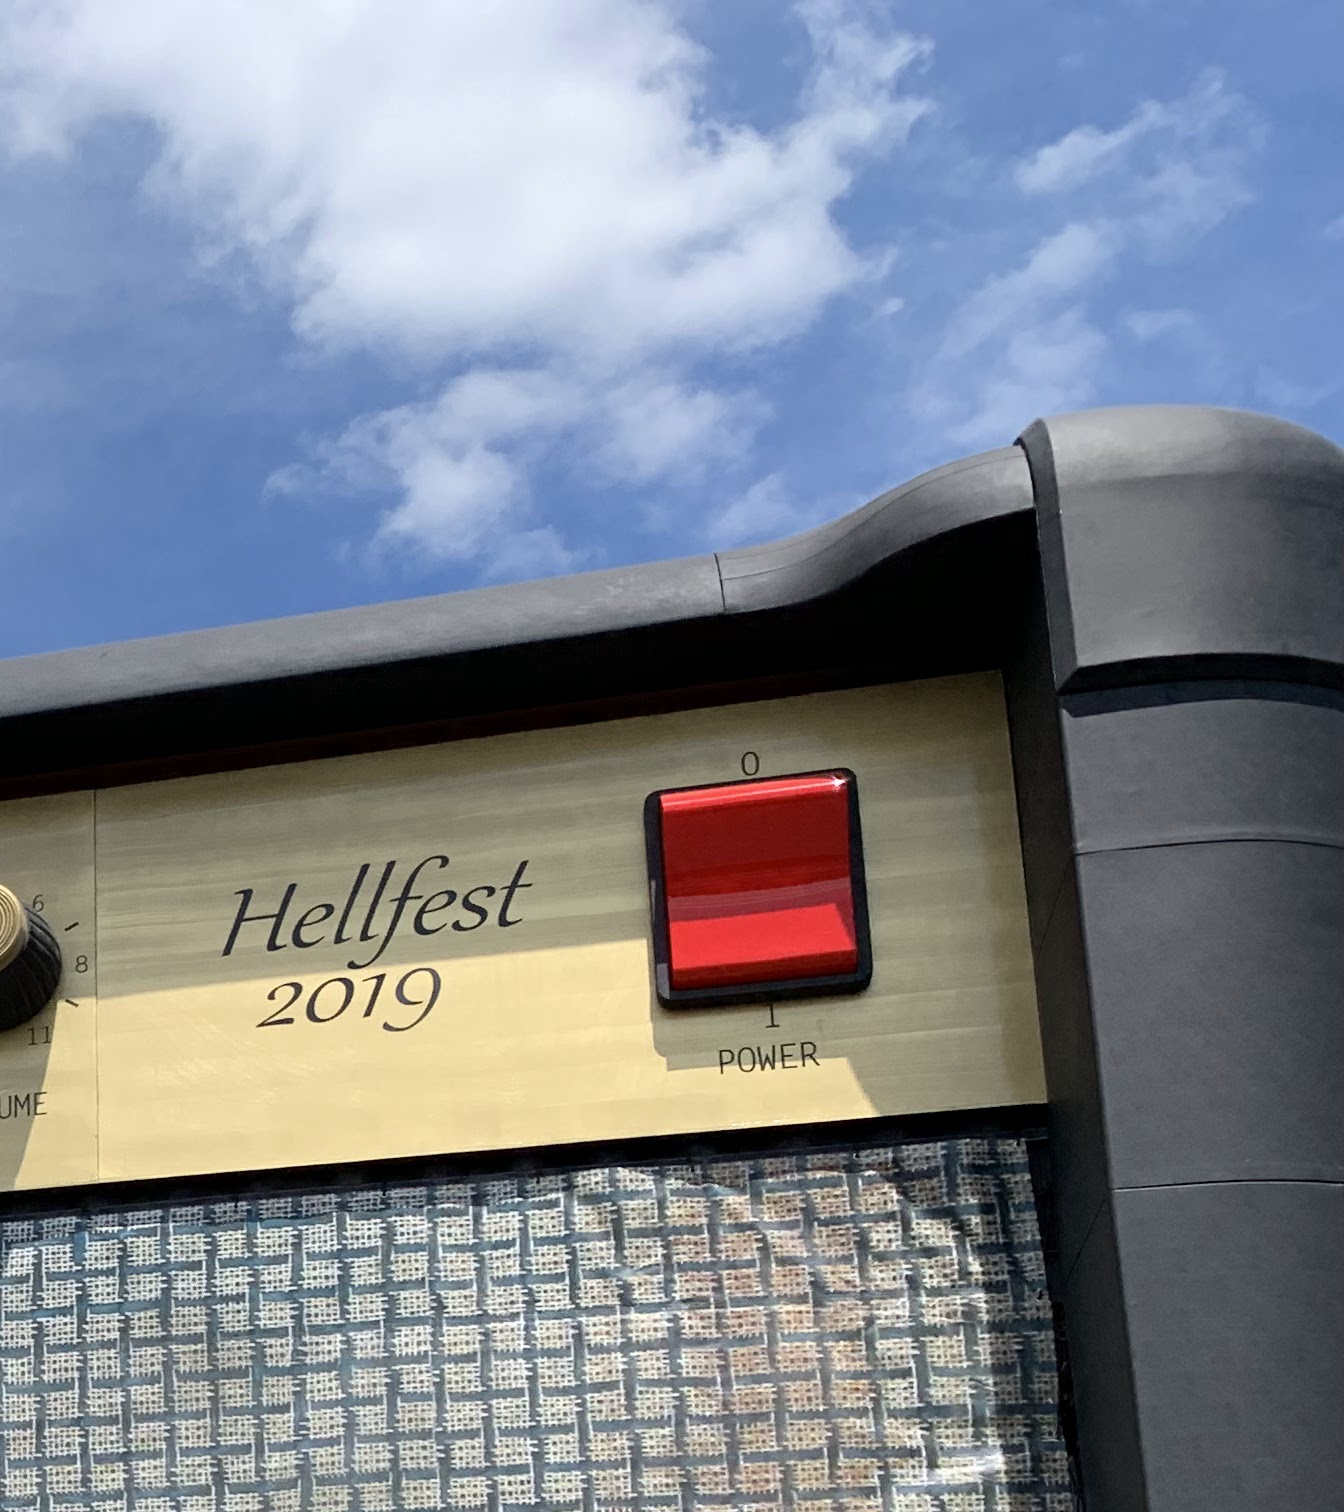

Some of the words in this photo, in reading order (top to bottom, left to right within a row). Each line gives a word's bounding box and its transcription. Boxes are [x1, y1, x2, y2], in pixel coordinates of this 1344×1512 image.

[32, 894, 44, 913] 6
[221, 855, 532, 970] Hellfest
[75, 954, 88, 974] 8
[256, 967, 441, 1032] 2019
[27, 1025, 52, 1046] 11
[718, 1041, 820, 1074] POWER
